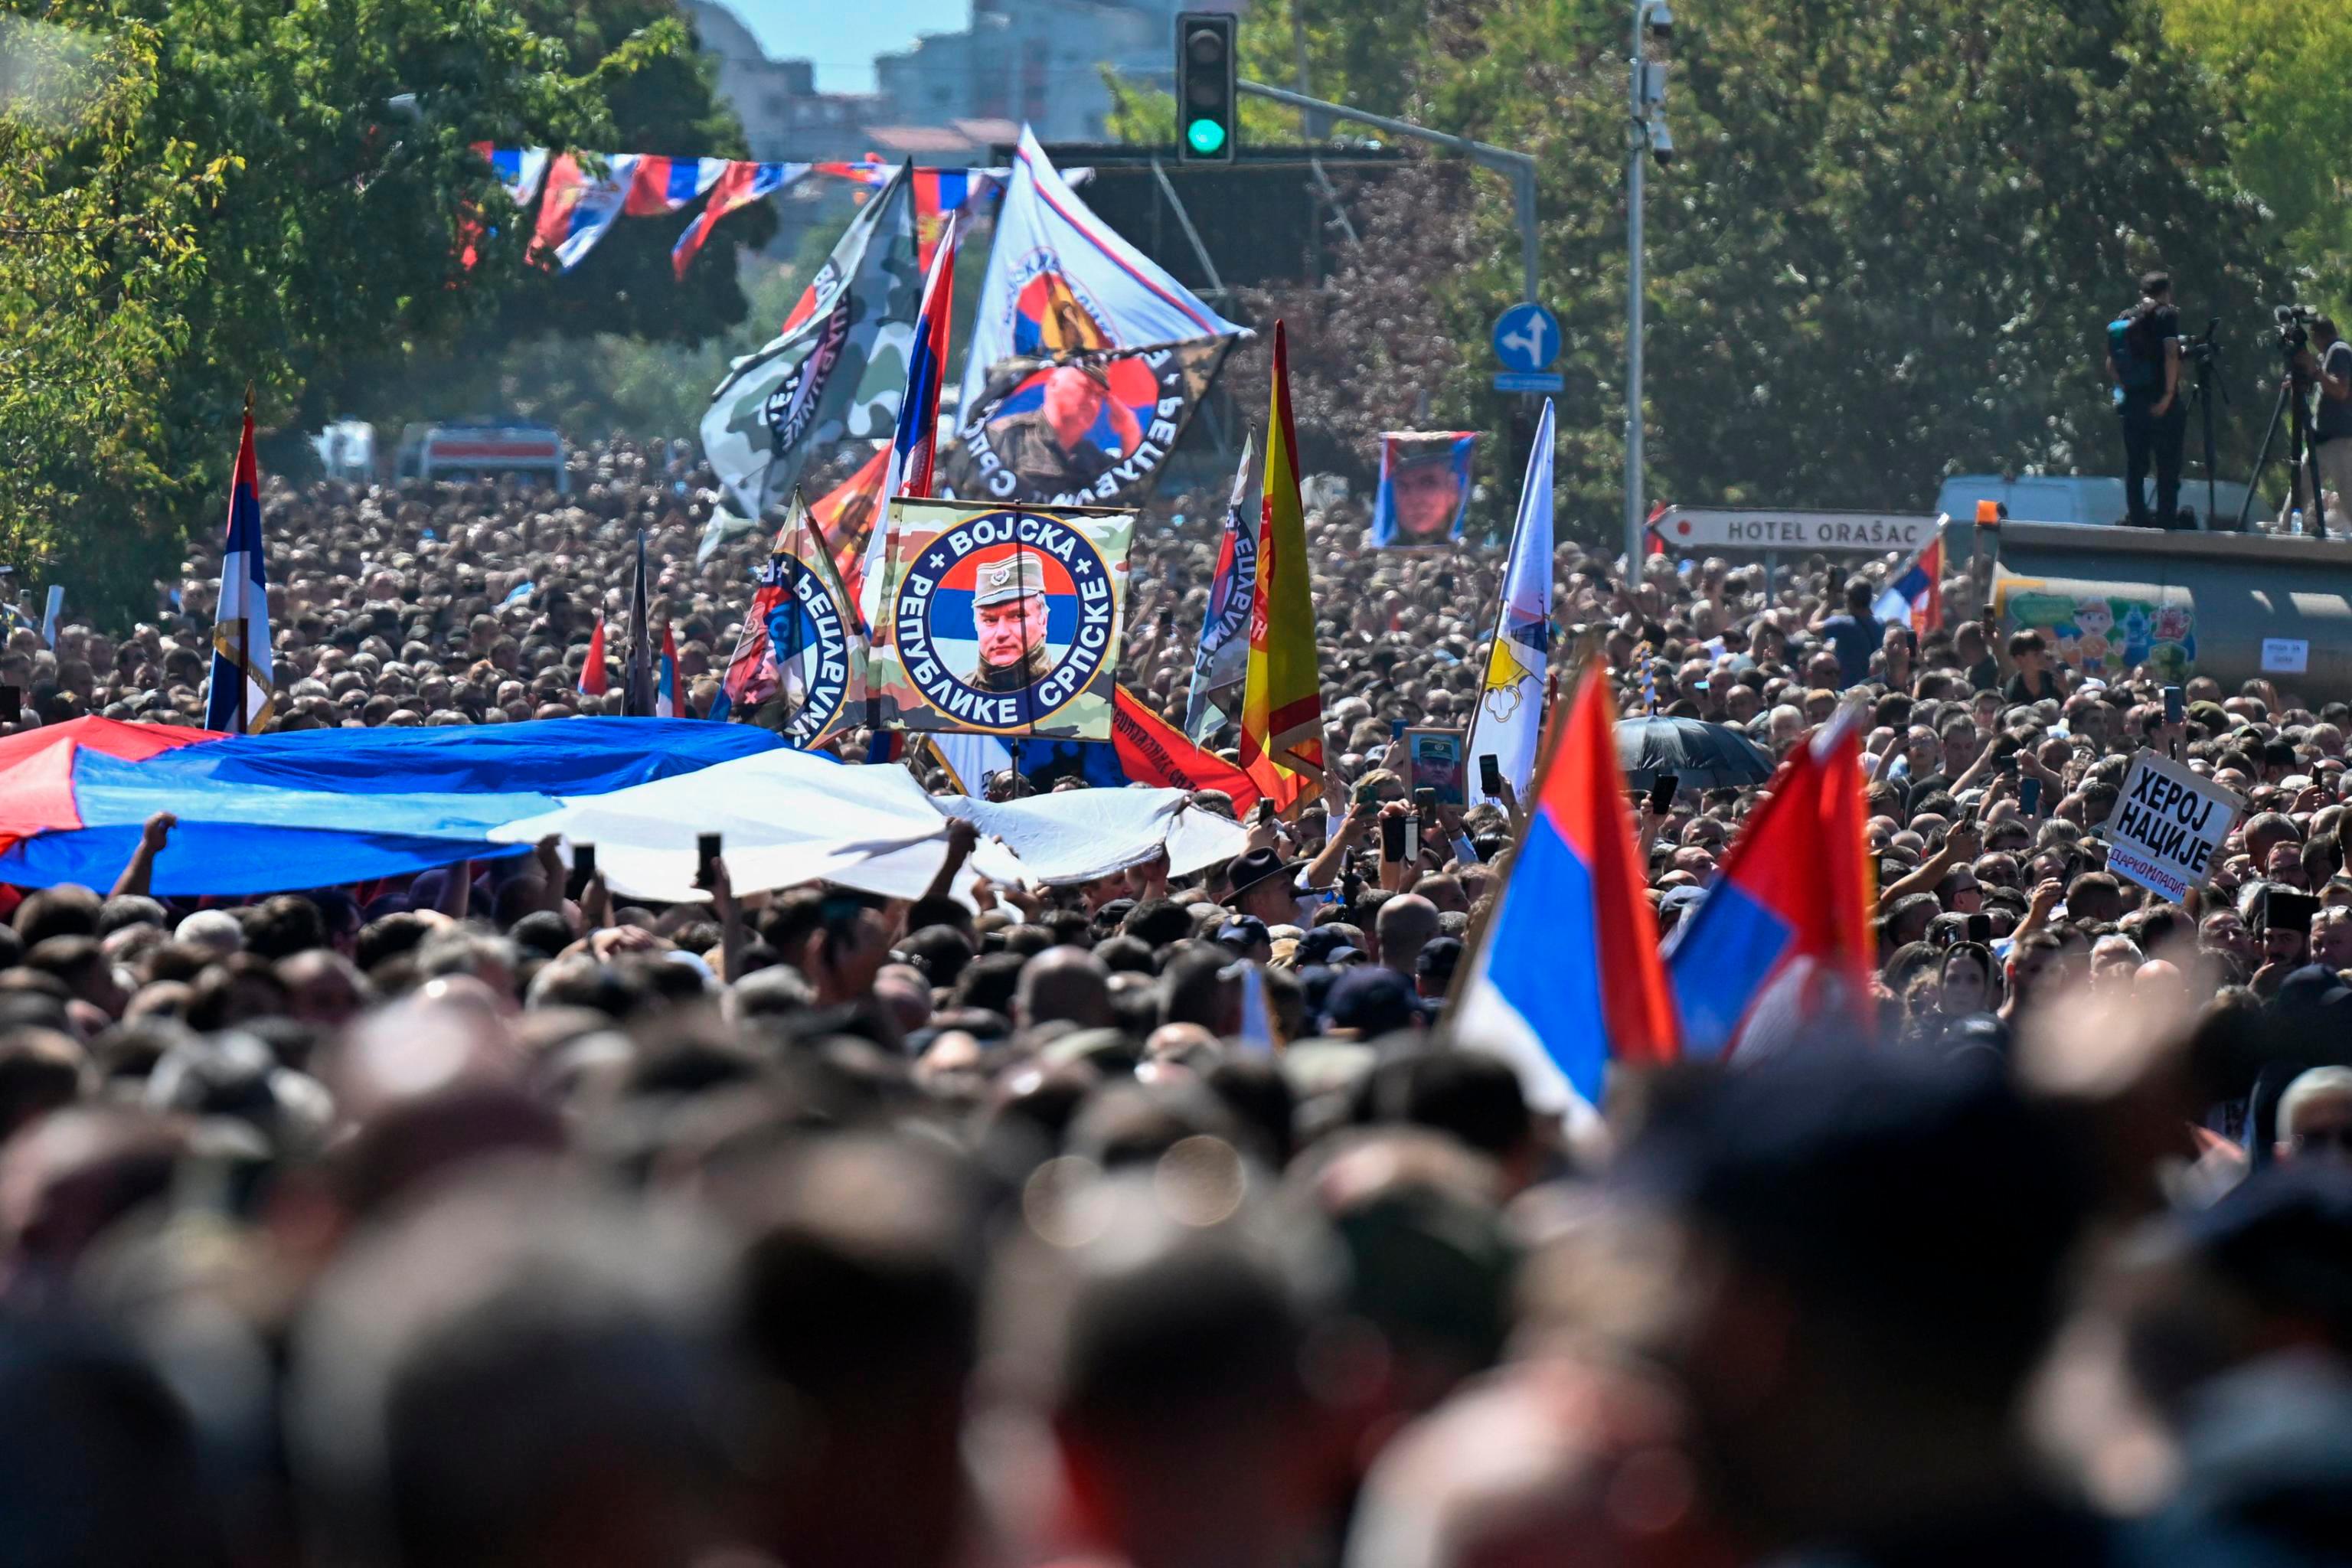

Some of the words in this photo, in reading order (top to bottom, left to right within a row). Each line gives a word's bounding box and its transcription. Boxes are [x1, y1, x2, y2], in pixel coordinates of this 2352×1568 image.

[948, 517, 1076, 562] ВОЈСКА
[1728, 521, 1808, 541] HOTEL
[1817, 520, 1919, 543] ORAŠAC
[899, 573, 1018, 724] РЕПУБЛИКЕ
[1038, 576, 1109, 707] СРПСКЕ
[2131, 766, 2214, 832] ХЕРОЈ
[2116, 801, 2213, 874] НАЦИЈЕ
